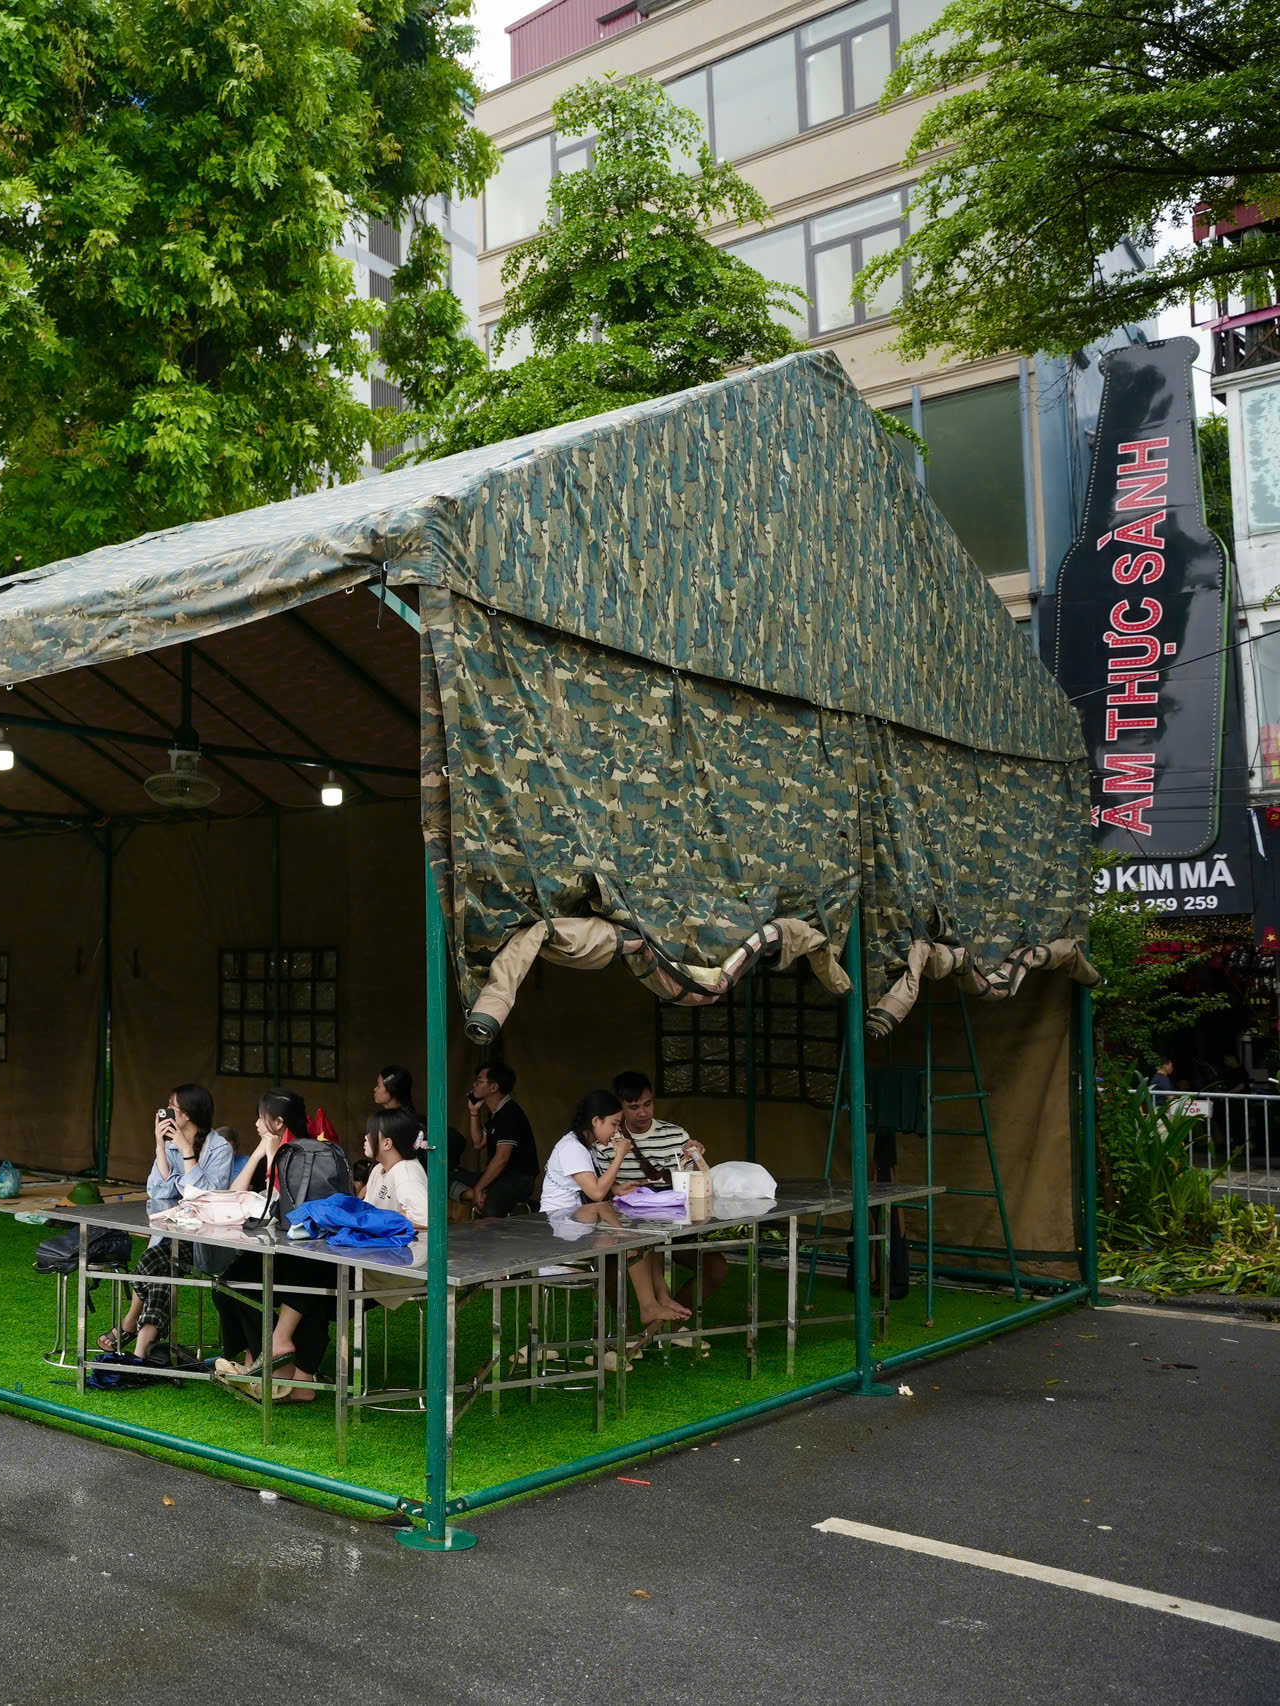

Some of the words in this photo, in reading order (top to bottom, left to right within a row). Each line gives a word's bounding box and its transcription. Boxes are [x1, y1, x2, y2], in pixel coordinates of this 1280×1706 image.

[1097, 436, 1169, 585] SÀNH
[1103, 597, 1176, 741] THỰC
[1116, 863, 1174, 893] KIM
[1179, 853, 1236, 889] MÃ
[1144, 897, 1178, 912] 259
[1183, 895, 1219, 910] 259
